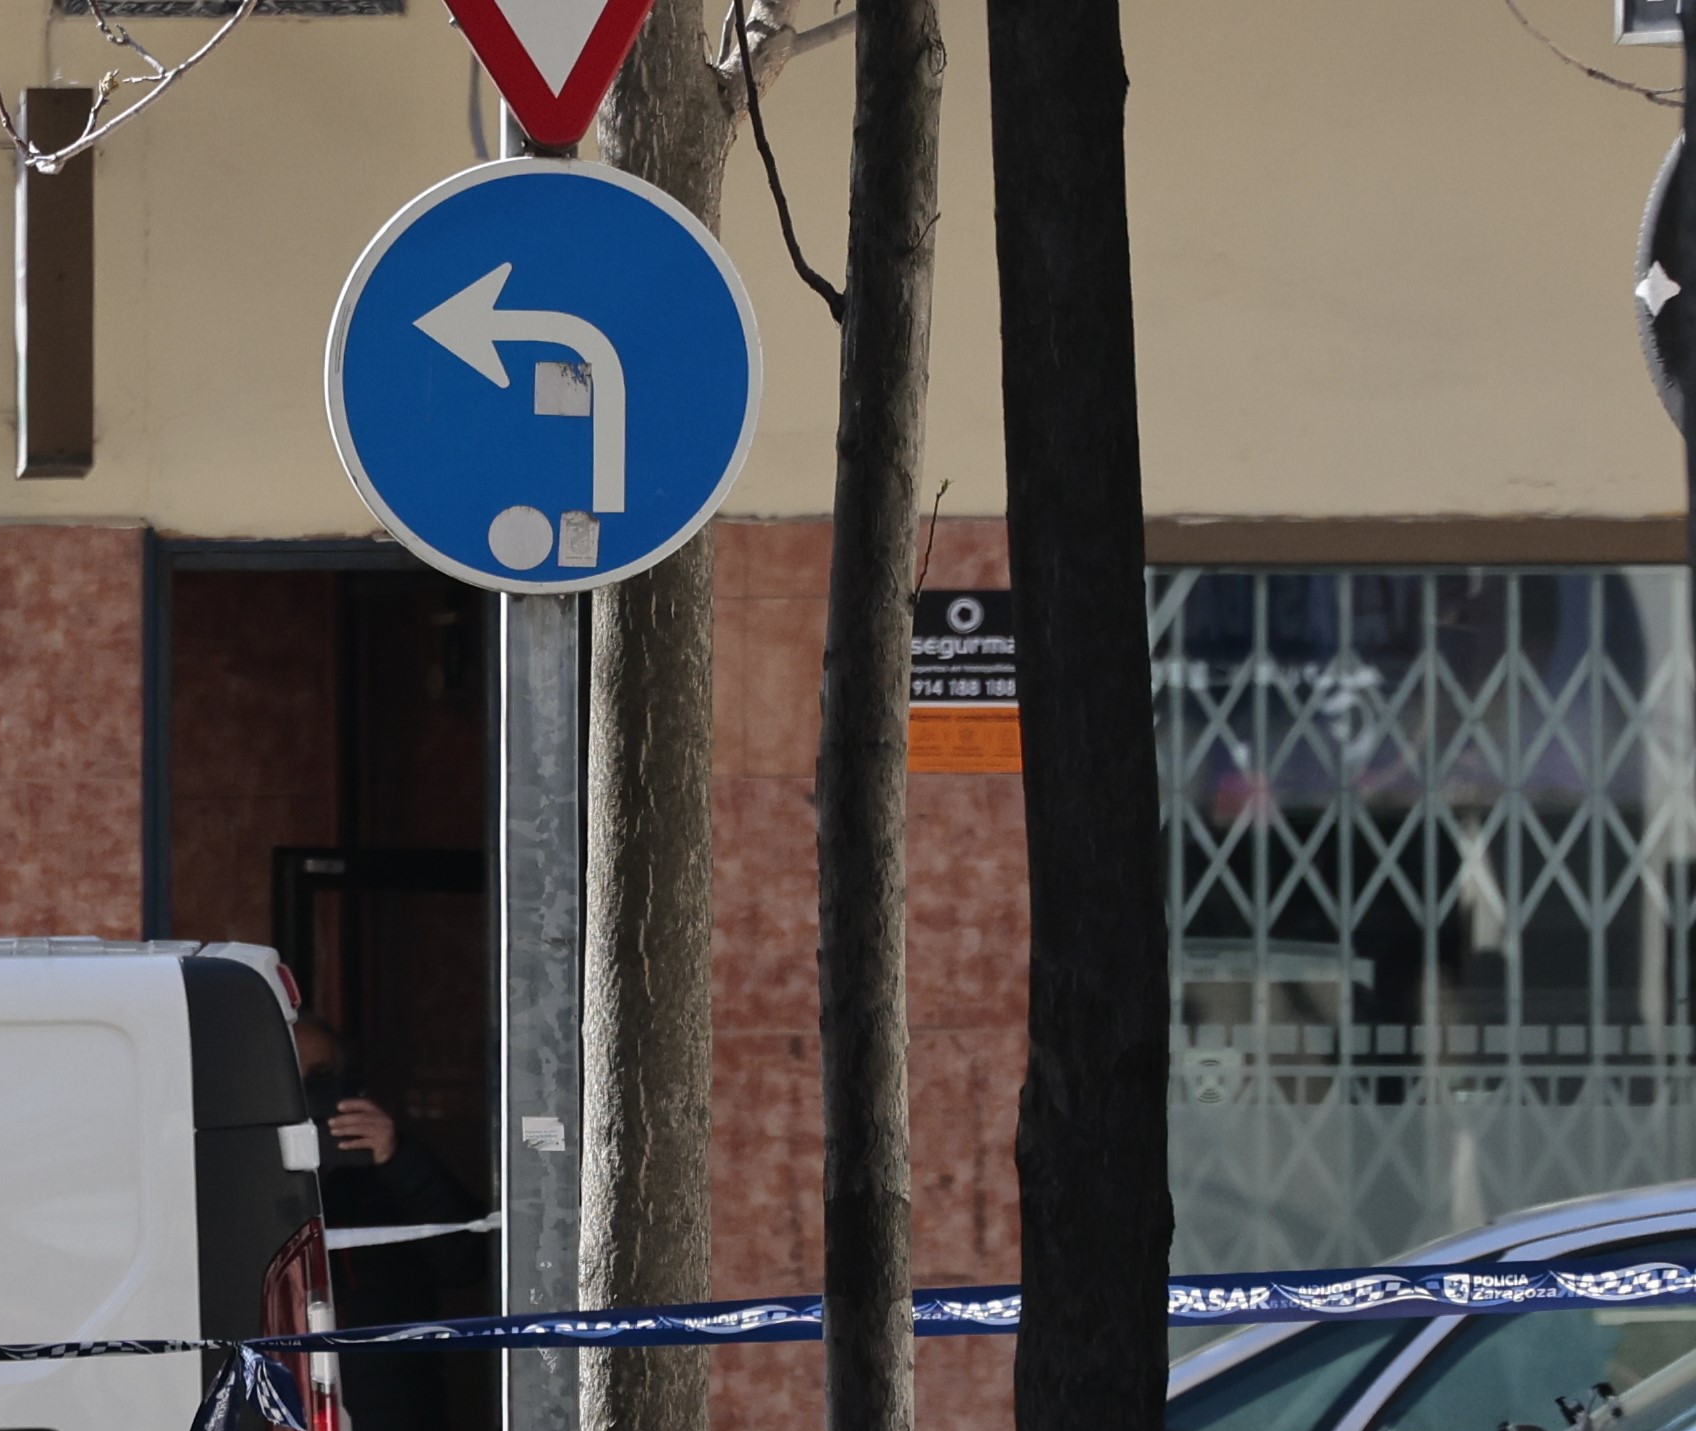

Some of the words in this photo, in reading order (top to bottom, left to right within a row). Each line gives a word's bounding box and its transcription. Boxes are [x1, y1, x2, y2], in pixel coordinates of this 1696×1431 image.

[912, 679, 944, 697] 914
[1474, 1273, 1528, 1287] POLICIA
[1472, 1284, 1557, 1303] Zaragoza
